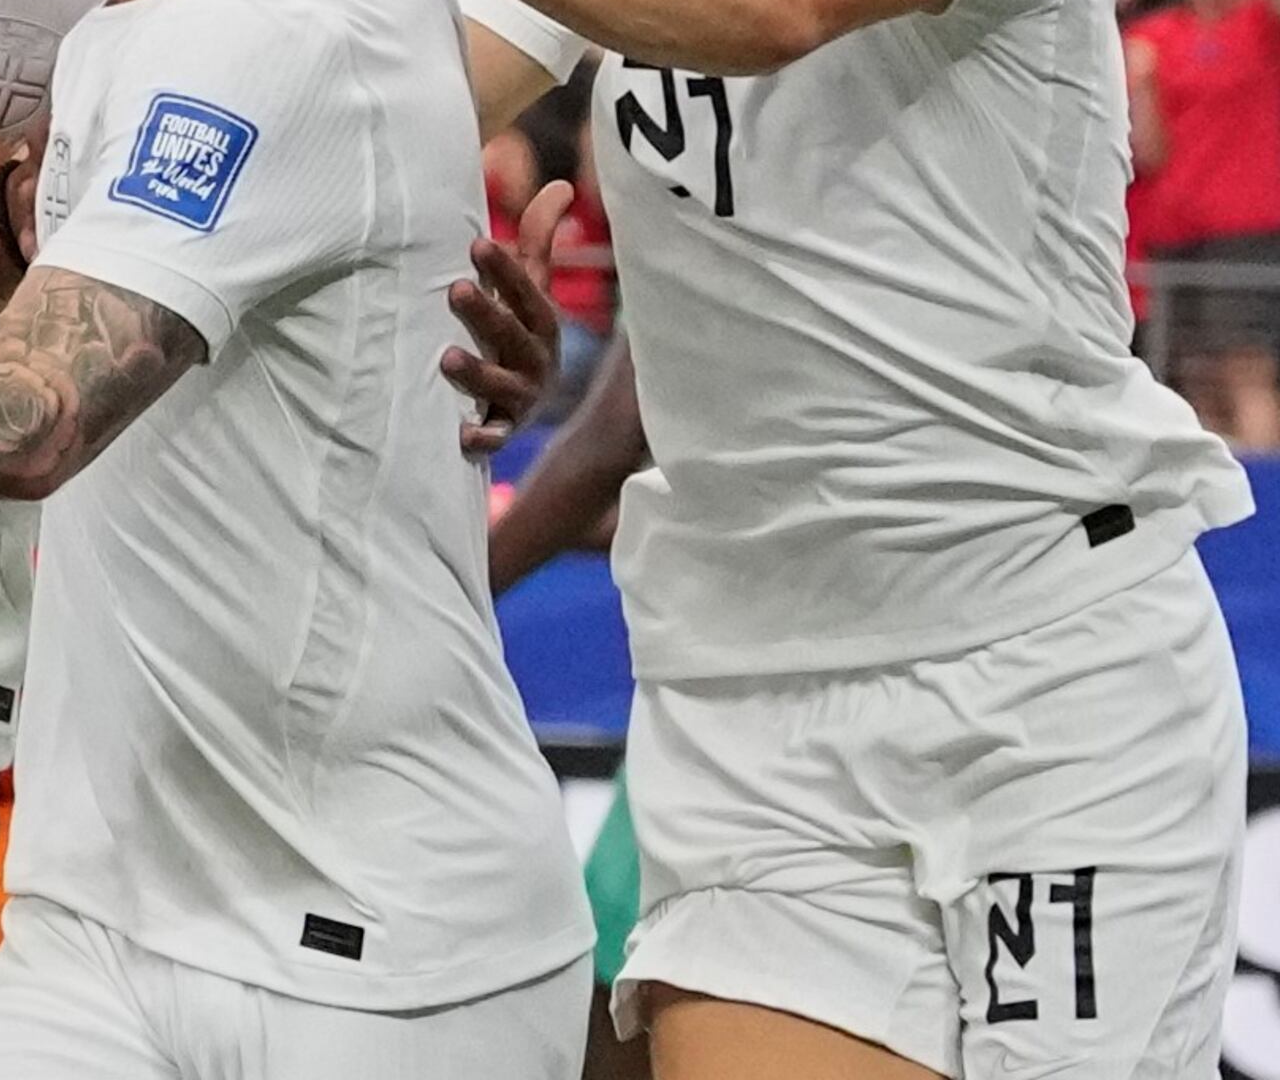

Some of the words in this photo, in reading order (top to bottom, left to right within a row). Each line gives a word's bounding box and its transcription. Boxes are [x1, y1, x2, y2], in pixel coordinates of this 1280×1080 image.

[151, 131, 225, 177] UNITES
[158, 112, 231, 155] FOOTBALL
[161, 158, 217, 201] World
[984, 865, 1099, 1025] 21
